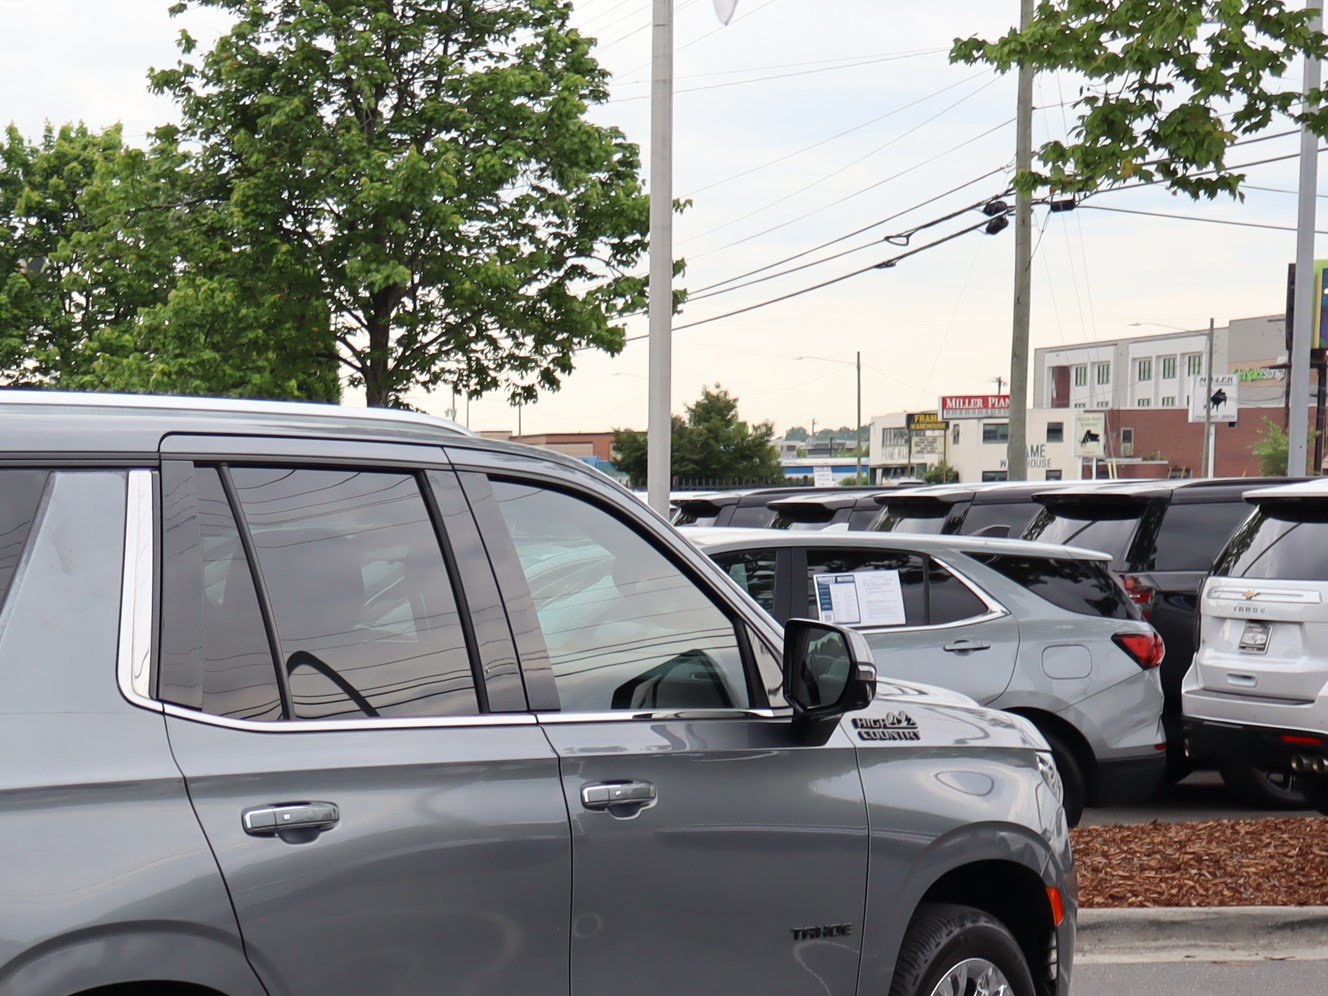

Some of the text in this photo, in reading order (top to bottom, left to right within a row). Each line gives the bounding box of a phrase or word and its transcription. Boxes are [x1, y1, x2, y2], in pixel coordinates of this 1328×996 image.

[946, 396, 1010, 409] MILLER PIAN
[851, 718, 890, 730] HIGH
[857, 730, 922, 741] COUNTRY
[791, 923, 853, 941] TAHOE
